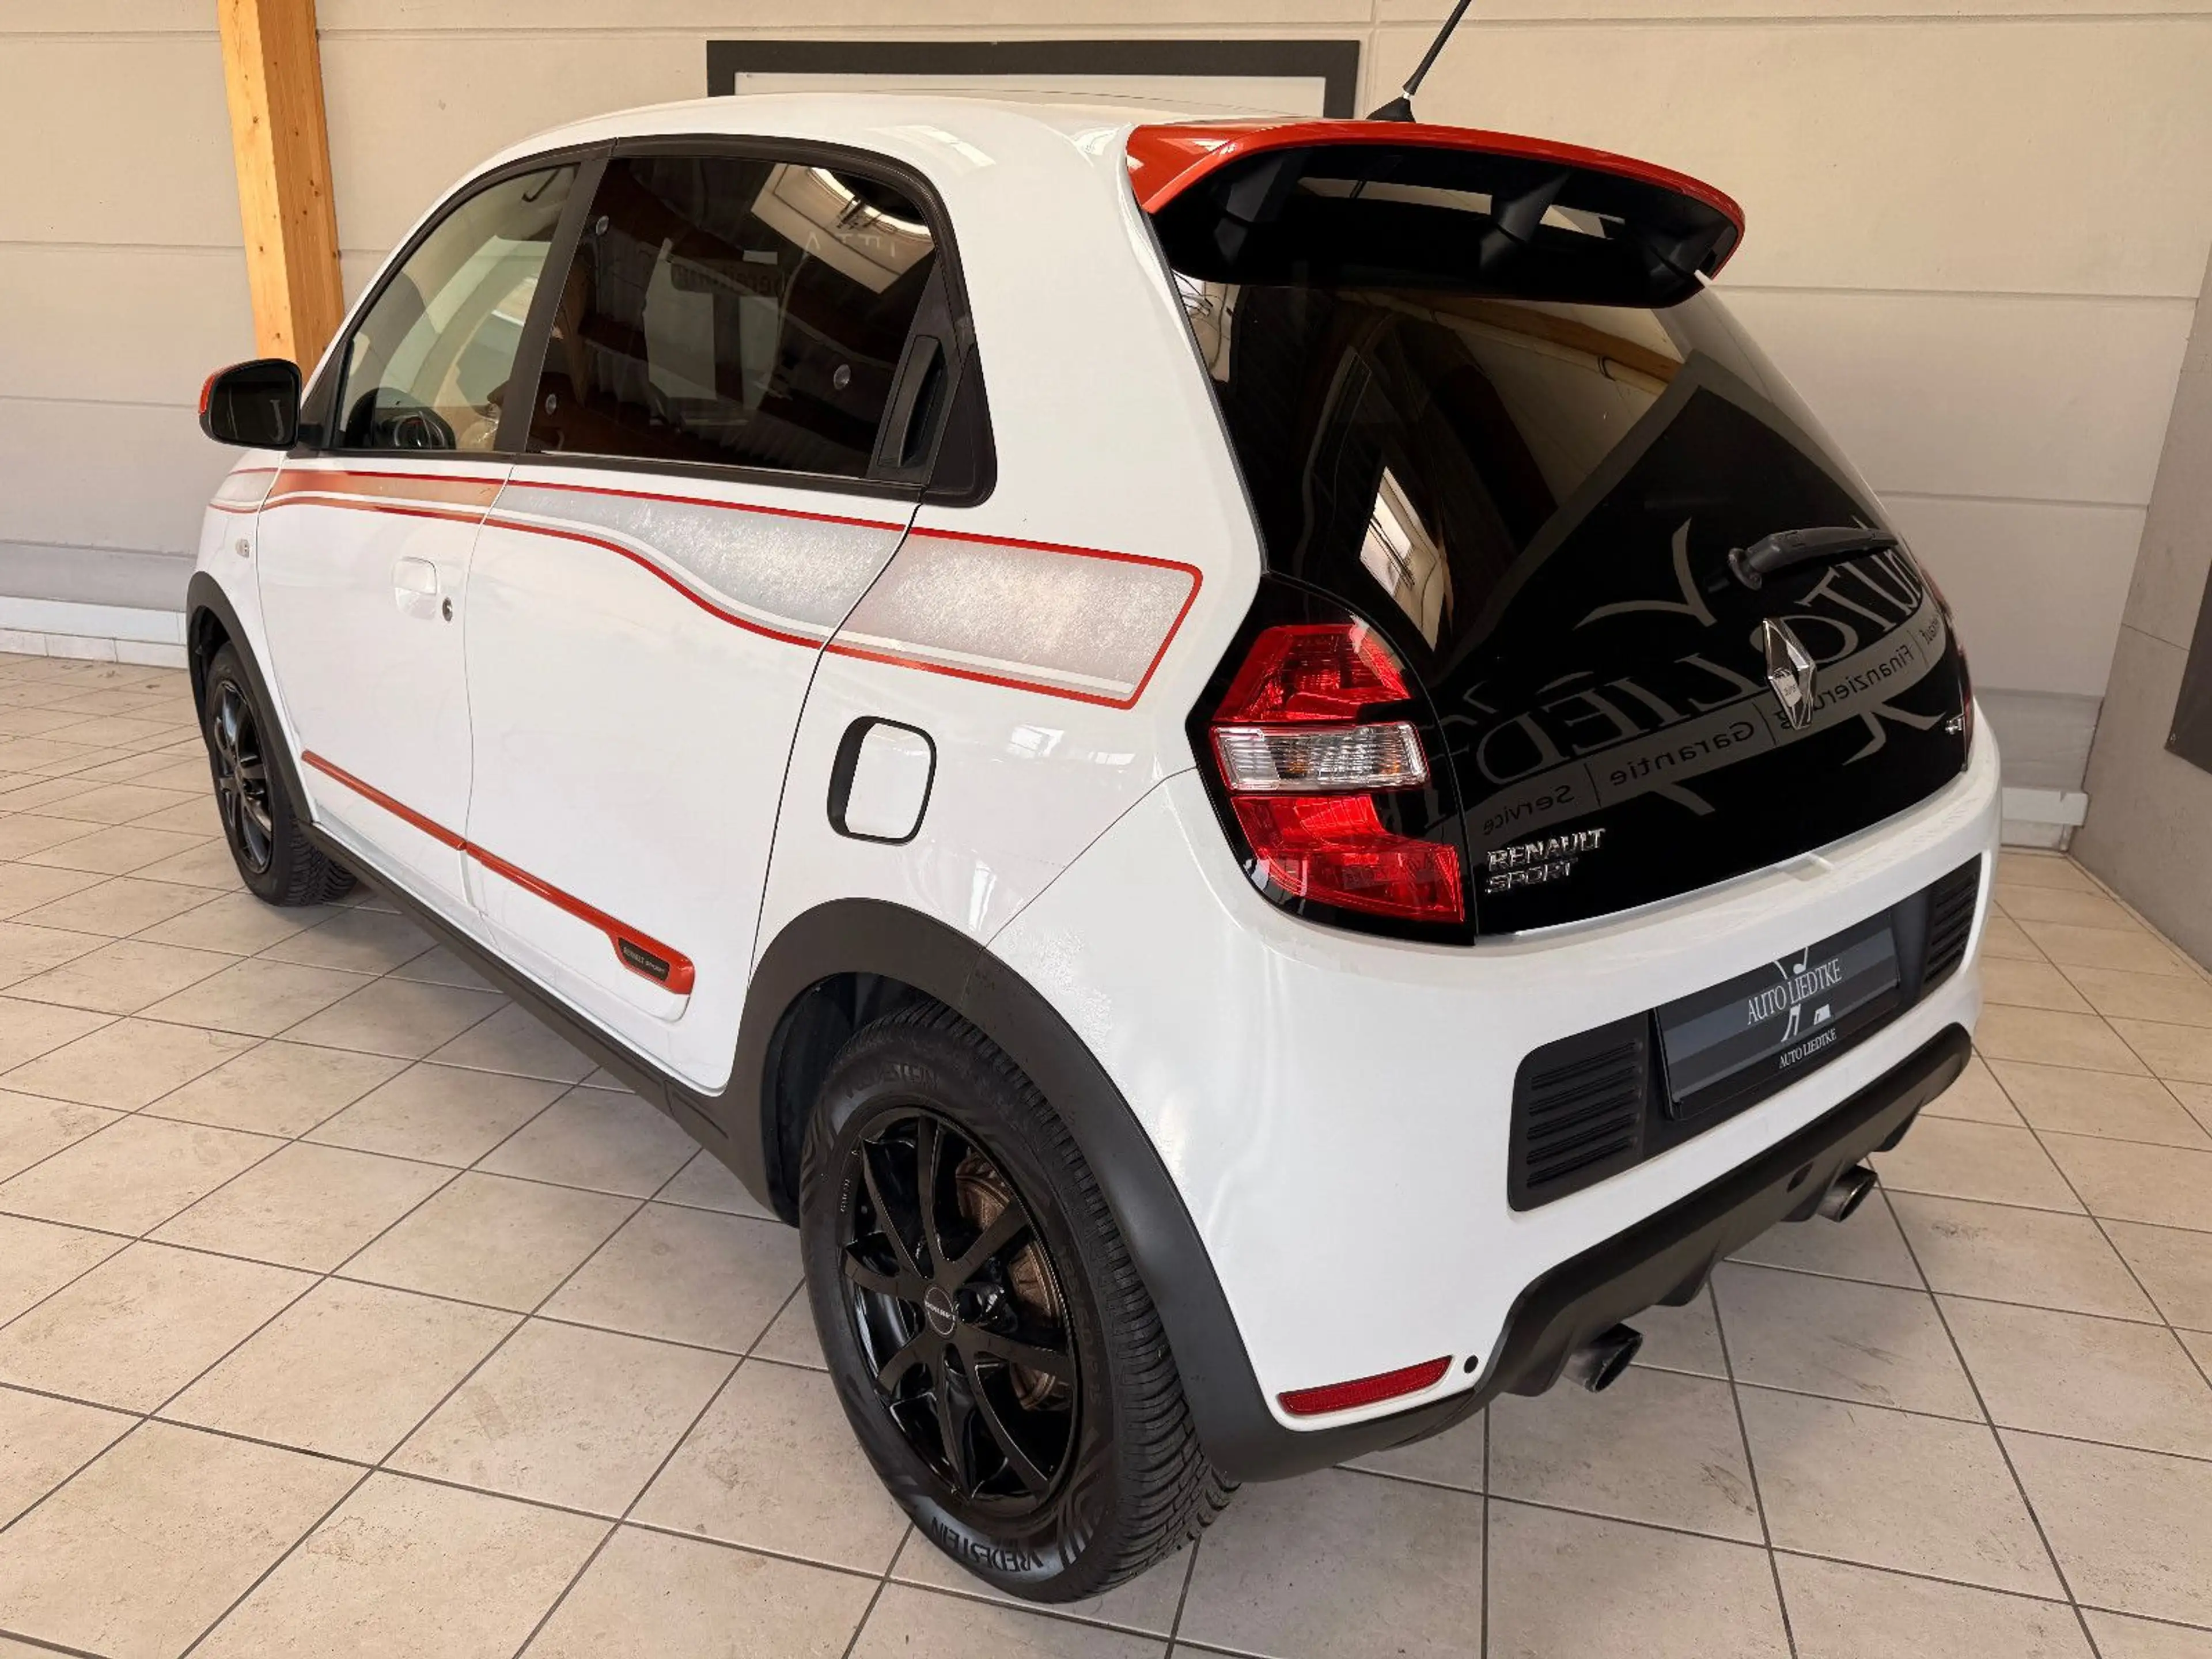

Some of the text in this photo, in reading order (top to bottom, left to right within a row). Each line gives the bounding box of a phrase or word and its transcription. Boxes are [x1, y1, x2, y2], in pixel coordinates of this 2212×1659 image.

[1486, 828, 1606, 872] RENAULT
[1484, 858, 1580, 895] SPORT
[1748, 958, 1842, 1025] AUTO LIEDTKE
[1779, 1028, 1837, 1069] AUTO LIEDTKE
[930, 1516, 1044, 1573] VREDESTEIN
